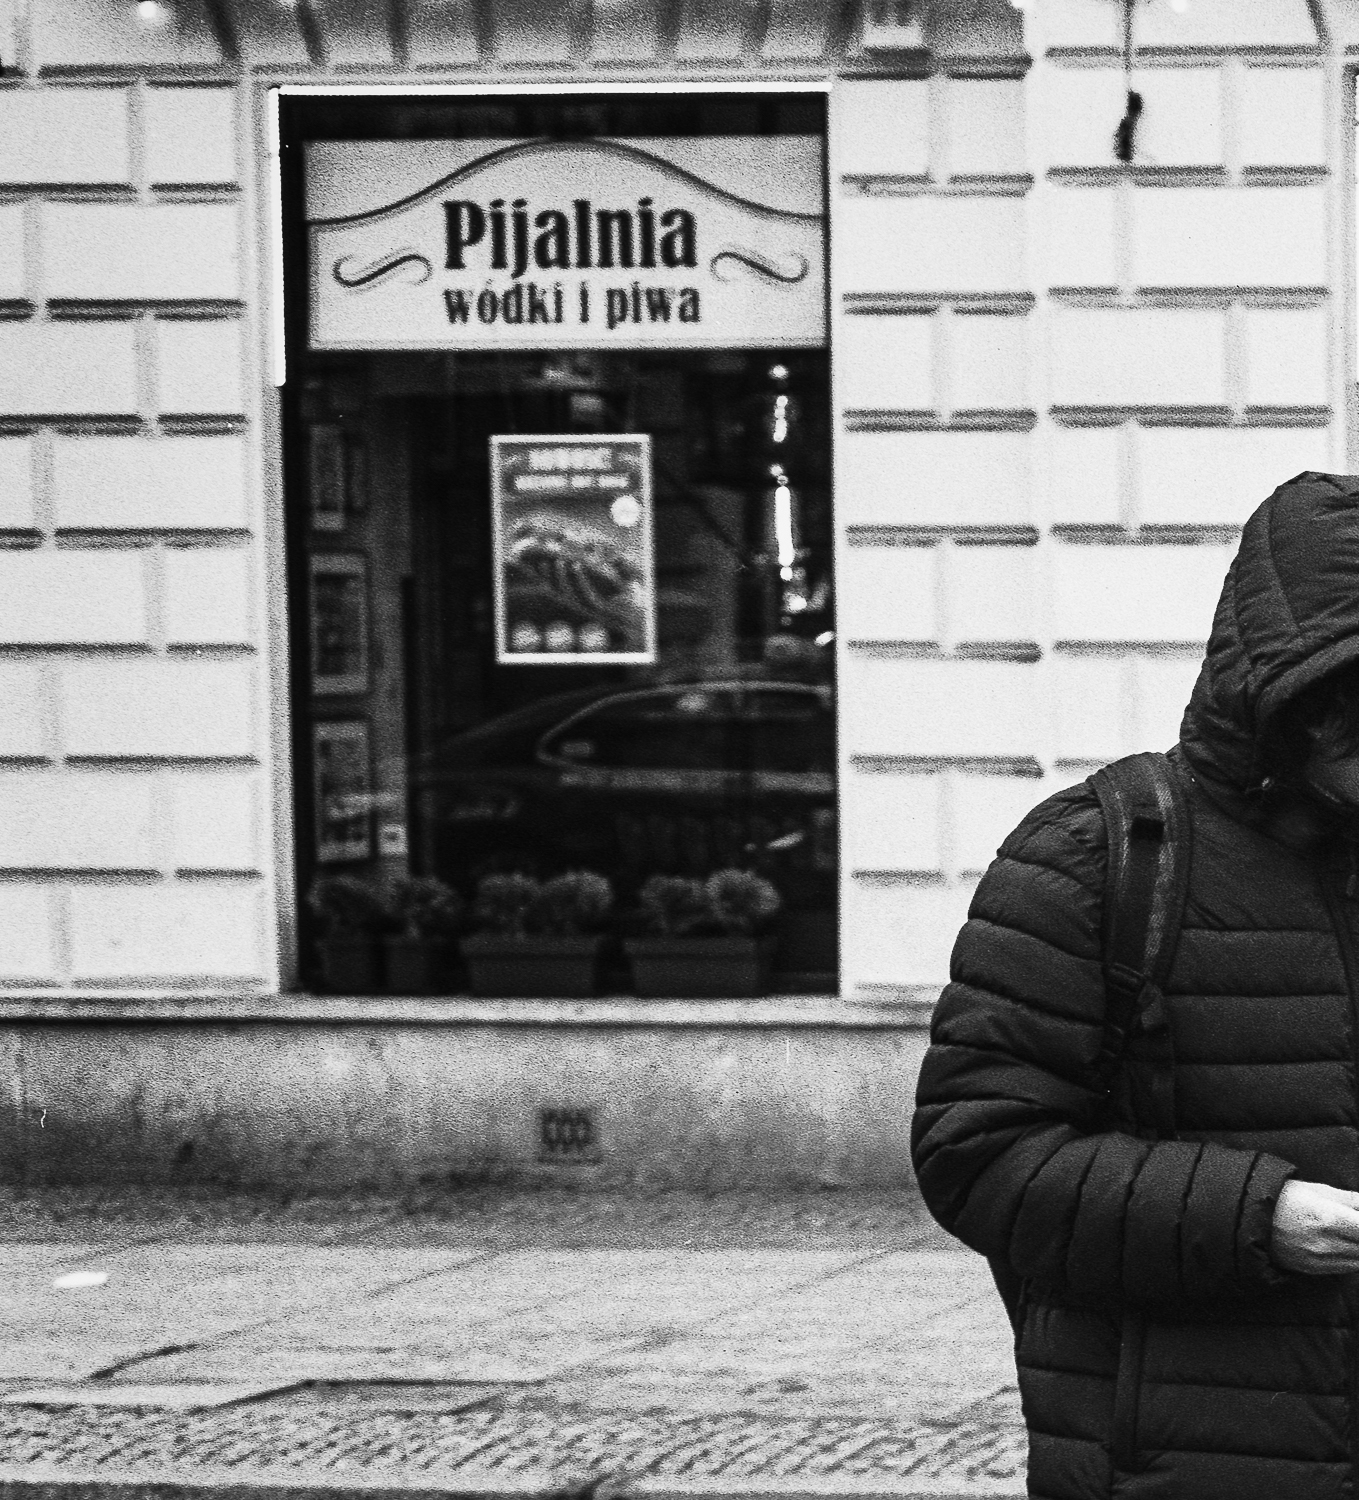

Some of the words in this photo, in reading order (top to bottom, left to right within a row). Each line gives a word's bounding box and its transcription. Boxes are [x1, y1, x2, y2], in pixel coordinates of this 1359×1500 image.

[441, 197, 698, 280] Pijalnia
[442, 278, 564, 324] wódki
[578, 281, 591, 324] i
[606, 280, 702, 330] piwa
